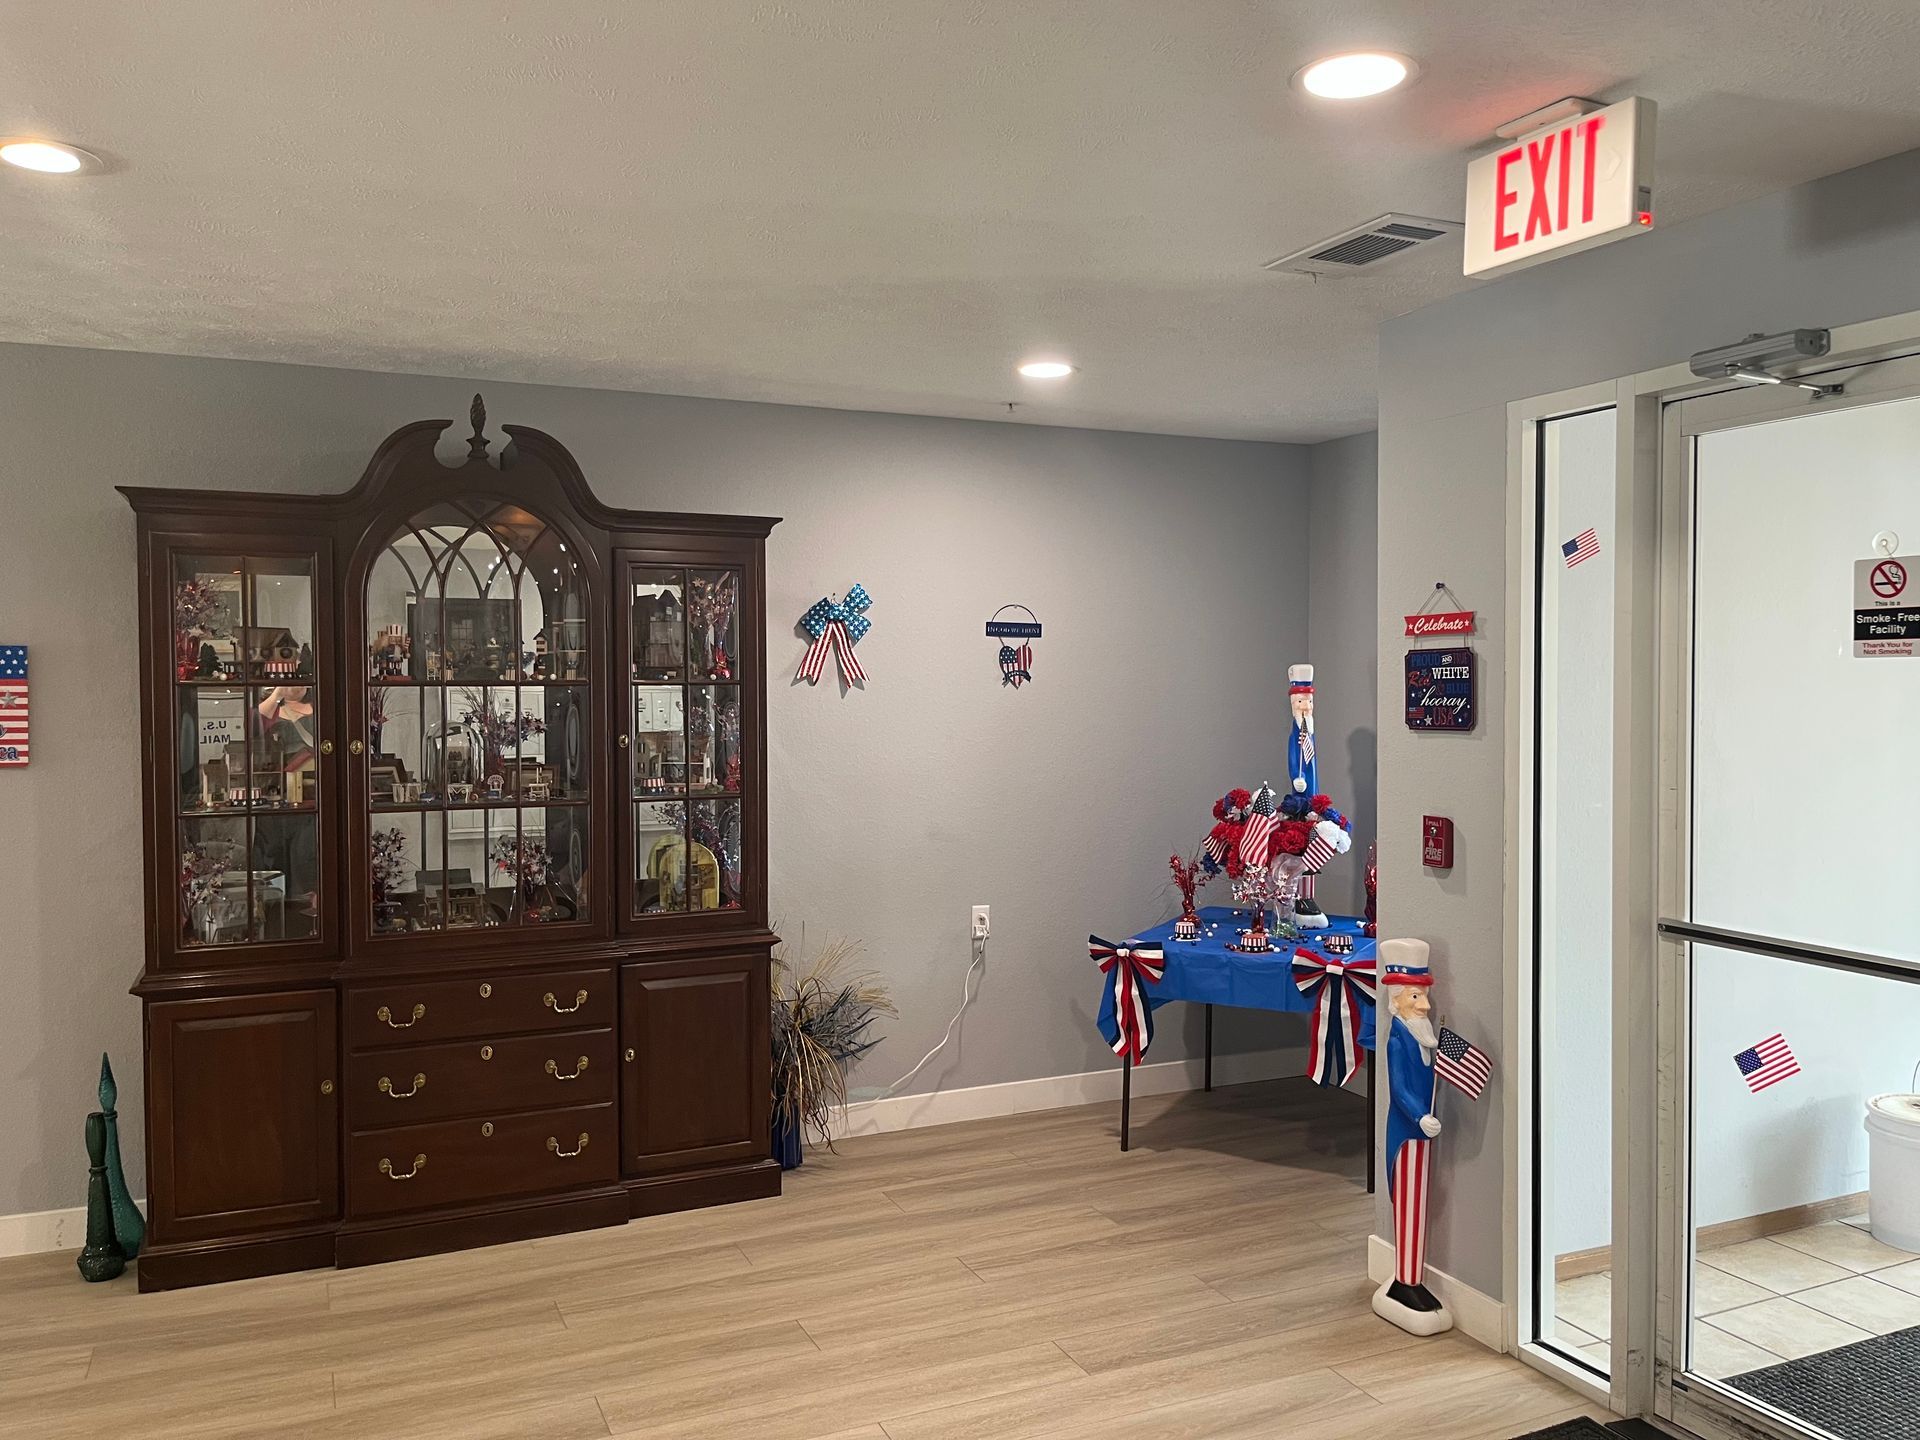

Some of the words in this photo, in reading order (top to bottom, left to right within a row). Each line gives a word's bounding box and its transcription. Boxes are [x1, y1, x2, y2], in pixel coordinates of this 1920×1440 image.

[1494, 115, 1606, 252] EXIT
[1414, 617, 1464, 633] Celebrate
[1856, 614, 1891, 624] Smoke
[1897, 613, 1920, 622] Free
[1869, 625, 1906, 635] Facility
[1411, 653, 1440, 666] PROUD
[1441, 655, 1453, 663] AND
[1408, 670, 1432, 687] Red
[1432, 667, 1469, 679] WHITE
[1446, 682, 1469, 694] BLUE
[1420, 685, 1467, 715] hooray
[1433, 707, 1455, 726] USA
[1425, 847, 1442, 858] FIRE
